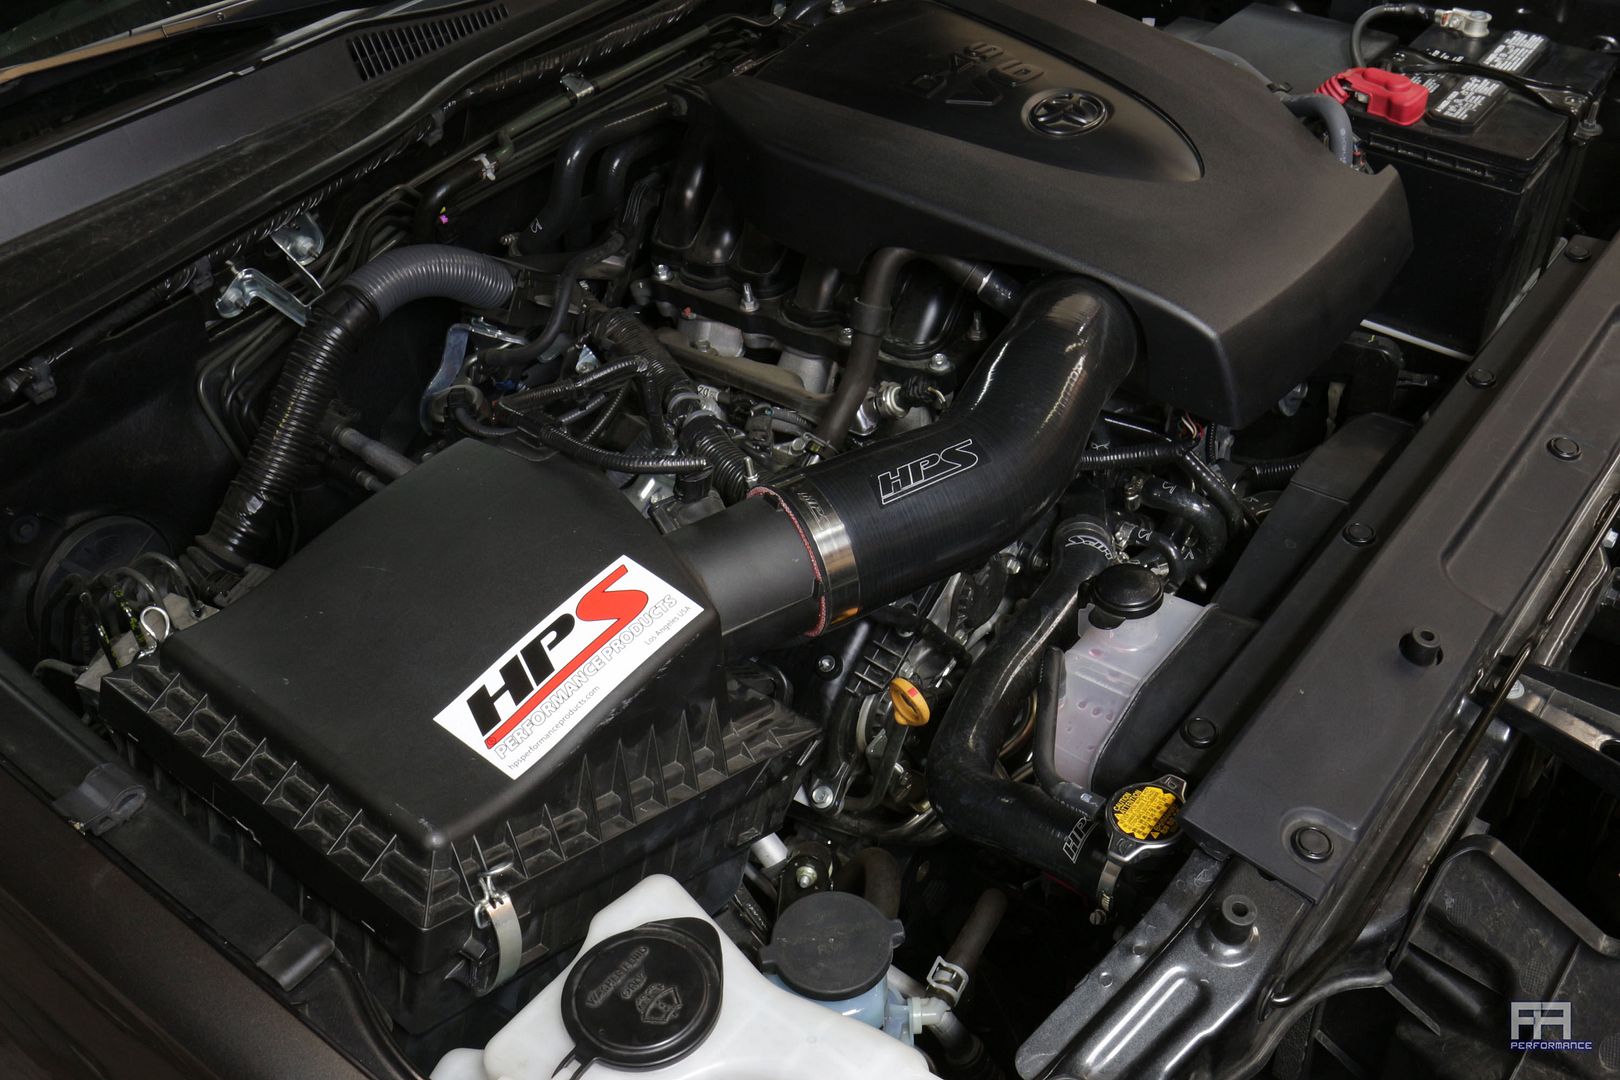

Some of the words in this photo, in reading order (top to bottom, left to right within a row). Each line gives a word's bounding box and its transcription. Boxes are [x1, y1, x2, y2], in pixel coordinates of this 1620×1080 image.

[877, 438, 979, 505] HPS
[643, 633, 657, 646] Los
[655, 613, 680, 639] Angeles
[677, 605, 692, 620] USA
[466, 564, 649, 750] HPS
[494, 654, 604, 760] PERFORMANCE
[601, 594, 678, 662] PRODUCTS
[507, 685, 600, 771] hpsperformanceproducts.com
[1113, 792, 1132, 811] CAUTION
[1120, 789, 1143, 814] ATTENTION
[1062, 816, 1100, 864] HP
